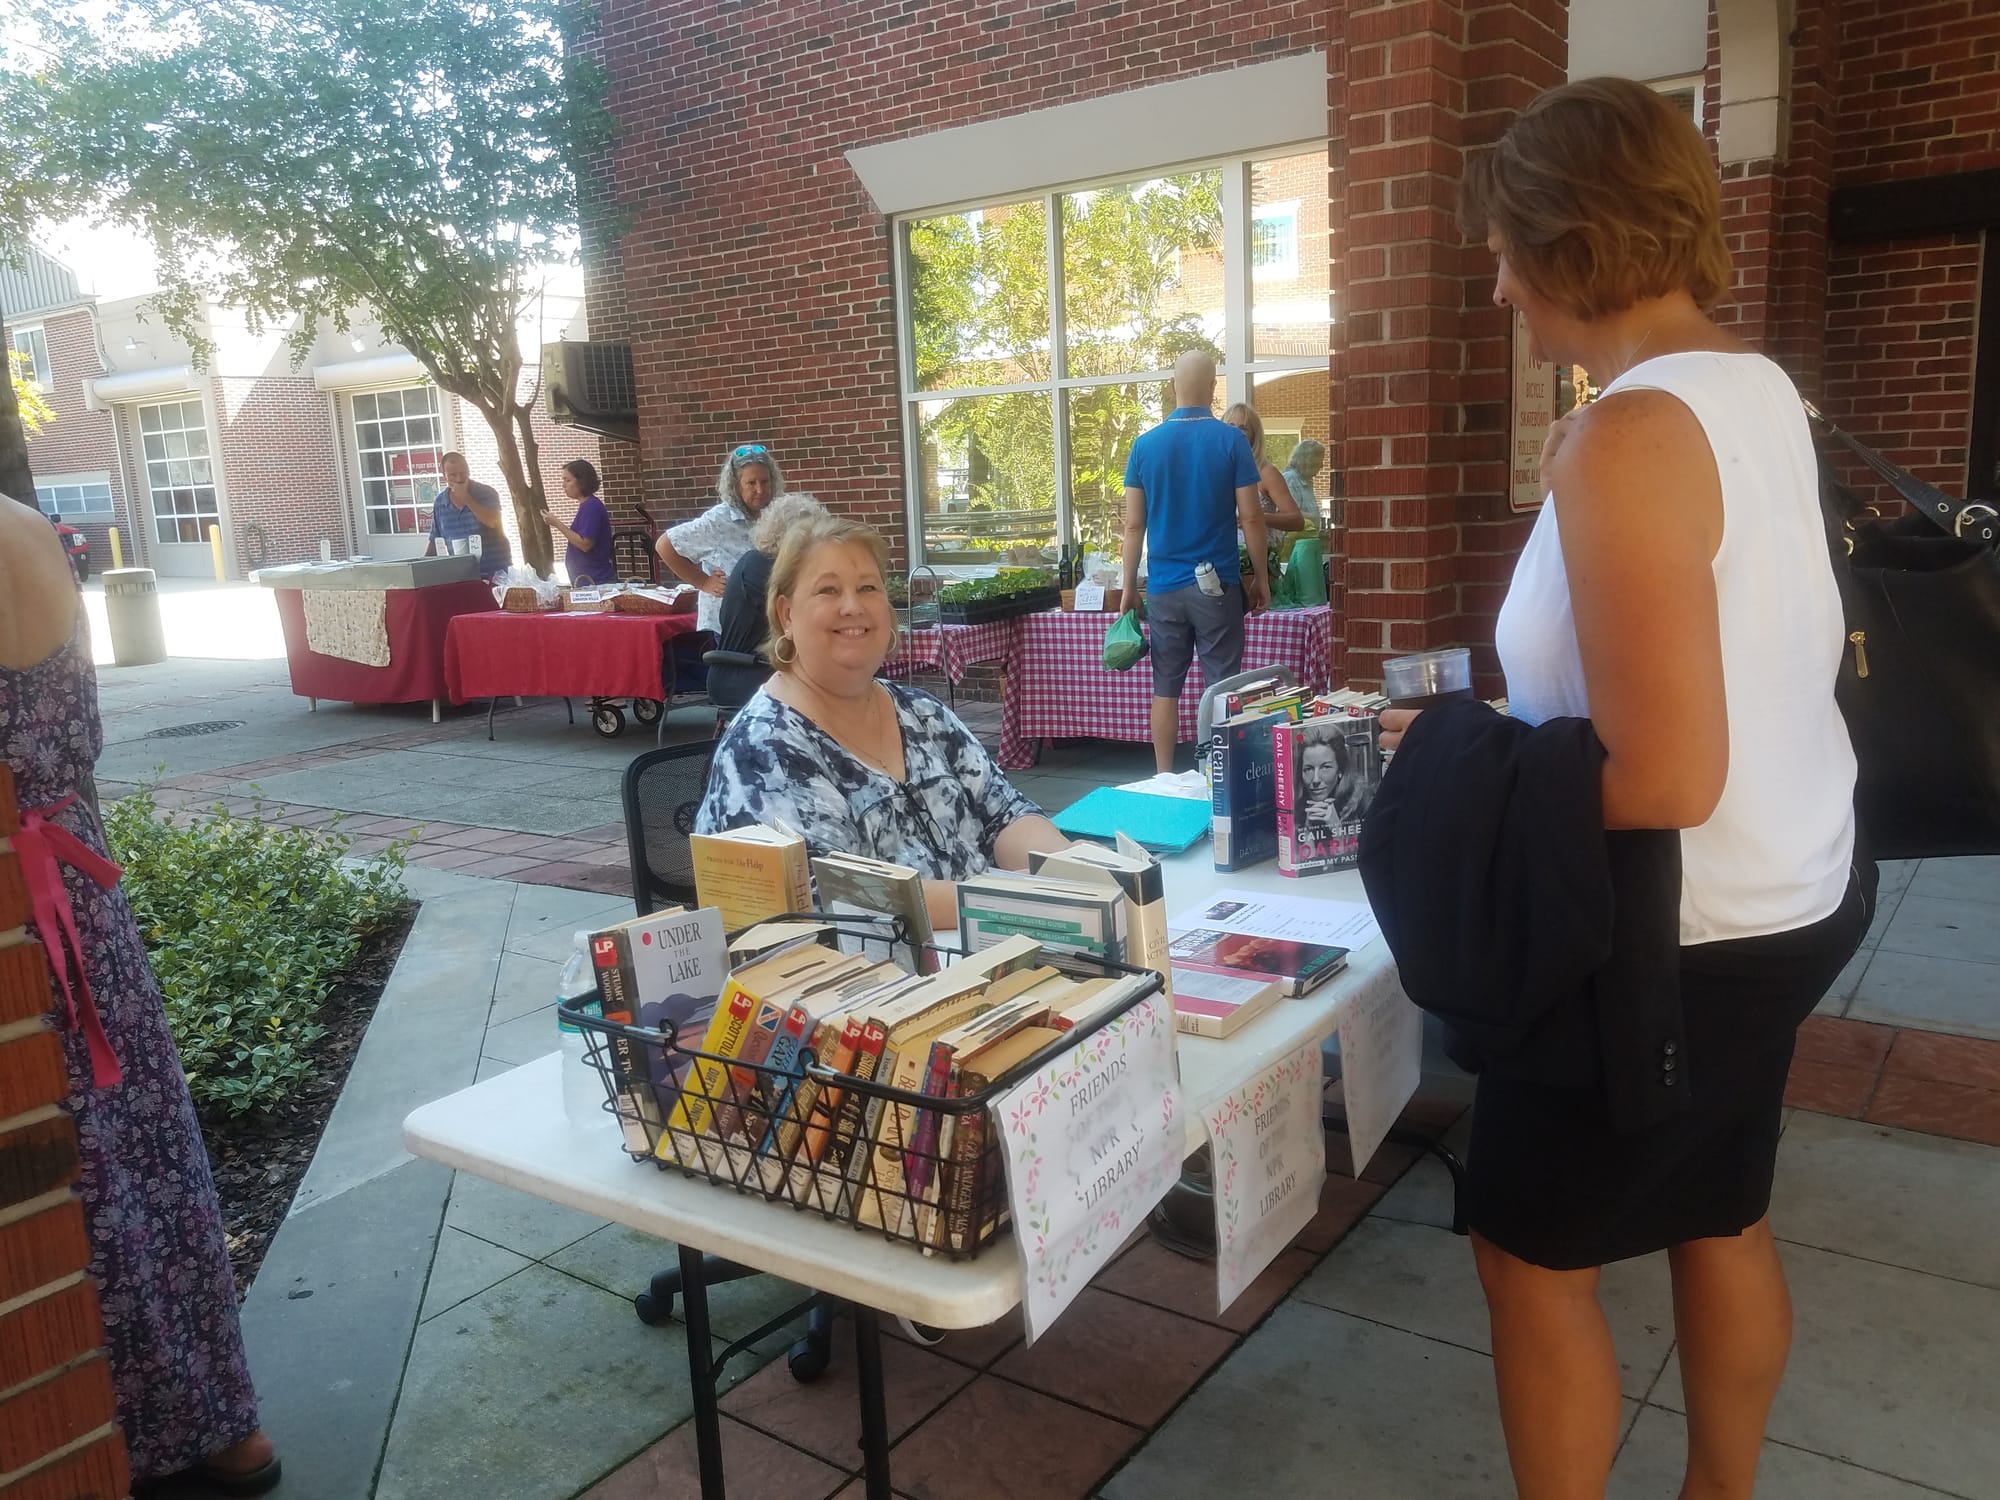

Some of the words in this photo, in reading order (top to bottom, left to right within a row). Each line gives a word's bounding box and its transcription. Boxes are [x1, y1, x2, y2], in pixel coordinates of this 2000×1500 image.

[1526, 382, 1545, 399] BICYCLE
[1520, 411, 1548, 427] SKATEBOARD
[1515, 469, 1530, 484] RIDING
[1317, 706, 1328, 714] LP
[1212, 734, 1229, 783] clean
[1277, 762, 1285, 806] SHEEHY
[1298, 829, 1327, 842] GAIL
[1332, 824, 1362, 838] SHEE
[746, 857, 764, 872] Help
[1327, 857, 1338, 865] MY
[1001, 913, 1018, 923] MOST
[1019, 916, 1047, 928] TRUSTED
[1048, 920, 1068, 930] GUIDE
[657, 921, 703, 950] UNDER
[1036, 931, 1071, 943] PUBLISHED
[595, 940, 614, 954] LP
[674, 947, 690, 958] THE
[668, 957, 702, 985] LAKE
[601, 971, 613, 1003] WOODS
[611, 968, 625, 1002] STUART
[734, 993, 753, 1009] LP
[791, 1008, 806, 1024] LP
[845, 1024, 861, 1039] LP
[864, 1024, 884, 1042] LP
[771, 1035, 792, 1067] GAP
[1069, 1053, 1127, 1117] FRIENDS
[1090, 1125, 1121, 1165] NPR
[1259, 1170, 1297, 1218] LIBRARY
